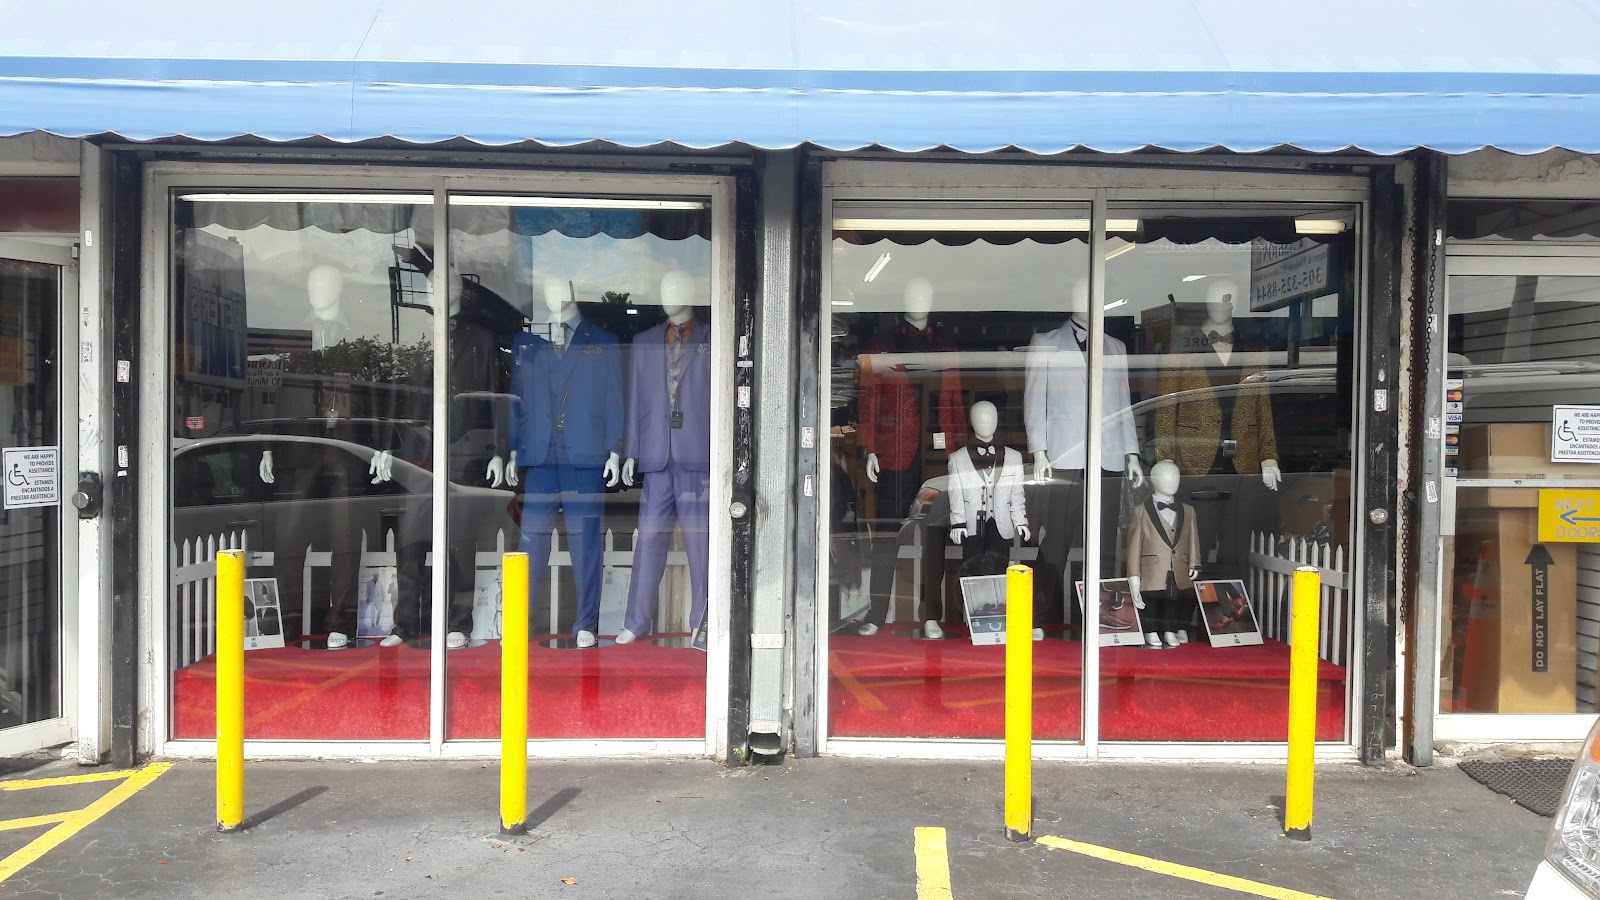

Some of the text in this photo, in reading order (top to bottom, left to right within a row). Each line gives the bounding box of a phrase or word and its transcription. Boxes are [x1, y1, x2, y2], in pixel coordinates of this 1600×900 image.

[1554, 498, 1595, 511] NEXT
[1535, 568, 1544, 668] DO NOT LAY FLAT
